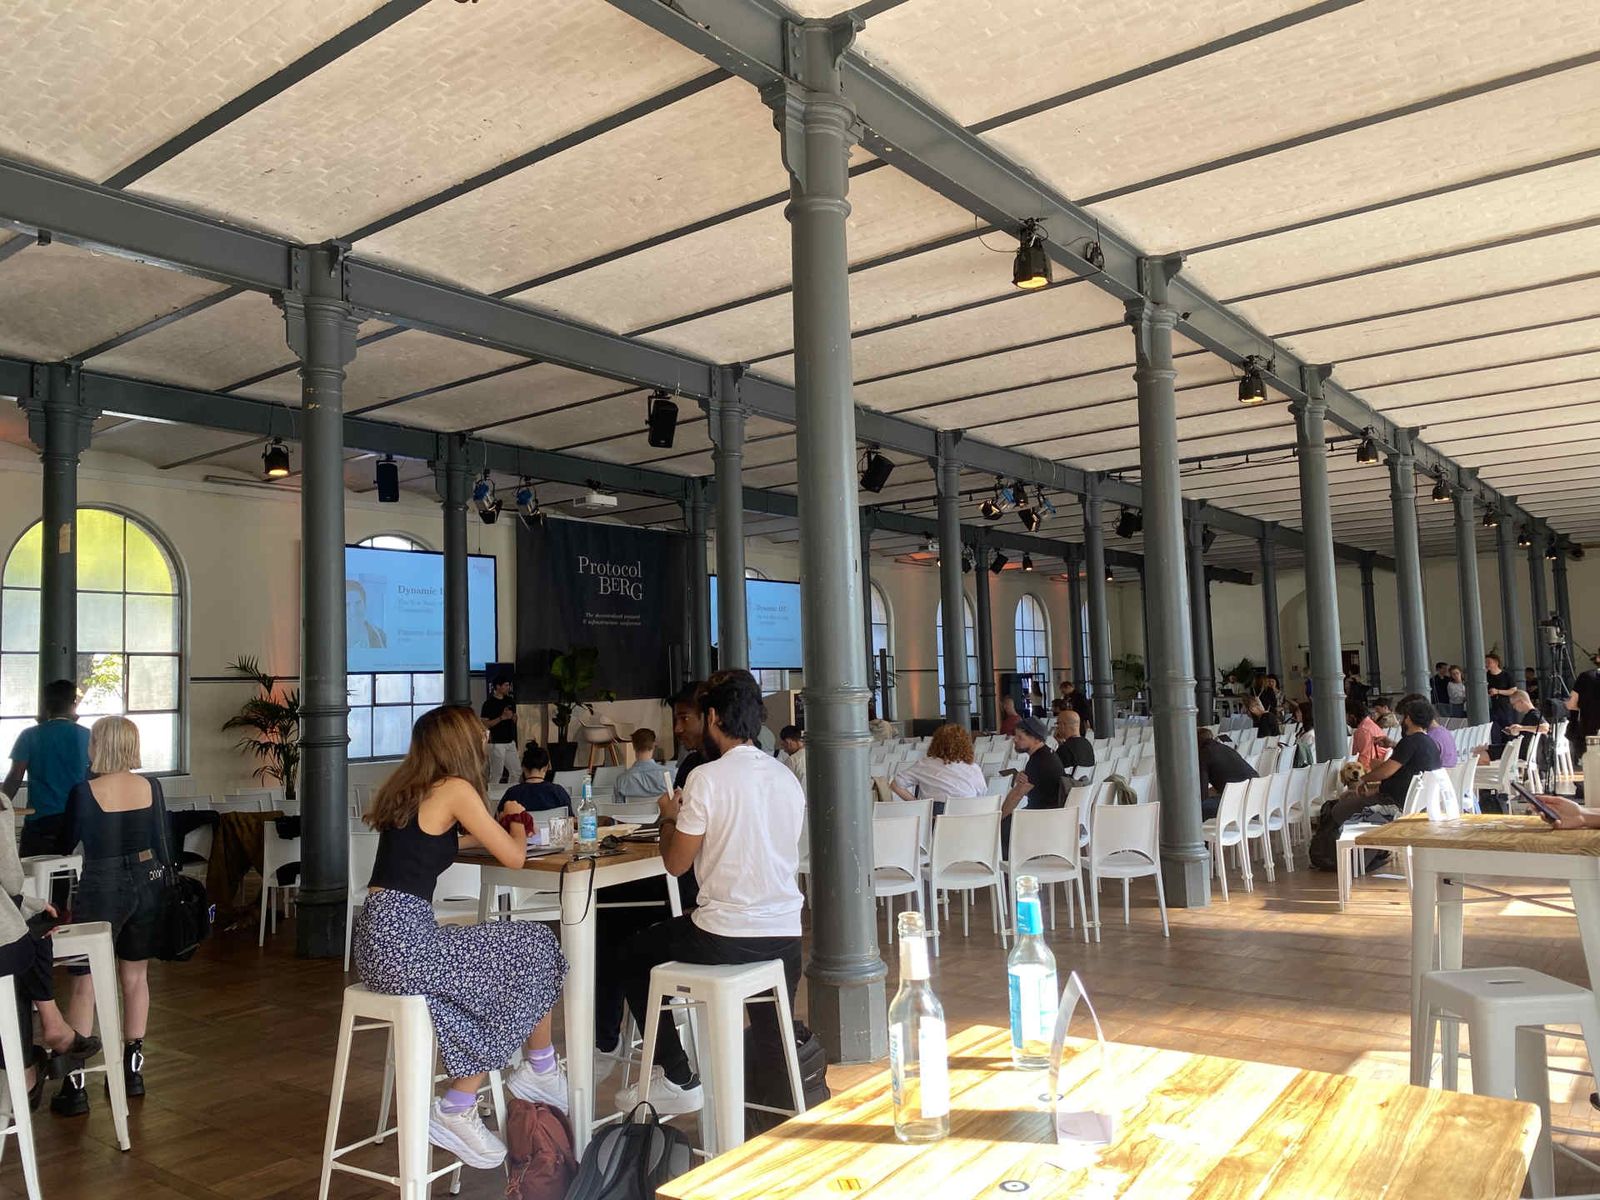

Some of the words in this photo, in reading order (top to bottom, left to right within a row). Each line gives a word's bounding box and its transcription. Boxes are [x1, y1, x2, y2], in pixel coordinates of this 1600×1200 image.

[577, 555, 642, 578] Protocol
[398, 585, 438, 596] Dynamic
[599, 576, 643, 601] BERG
